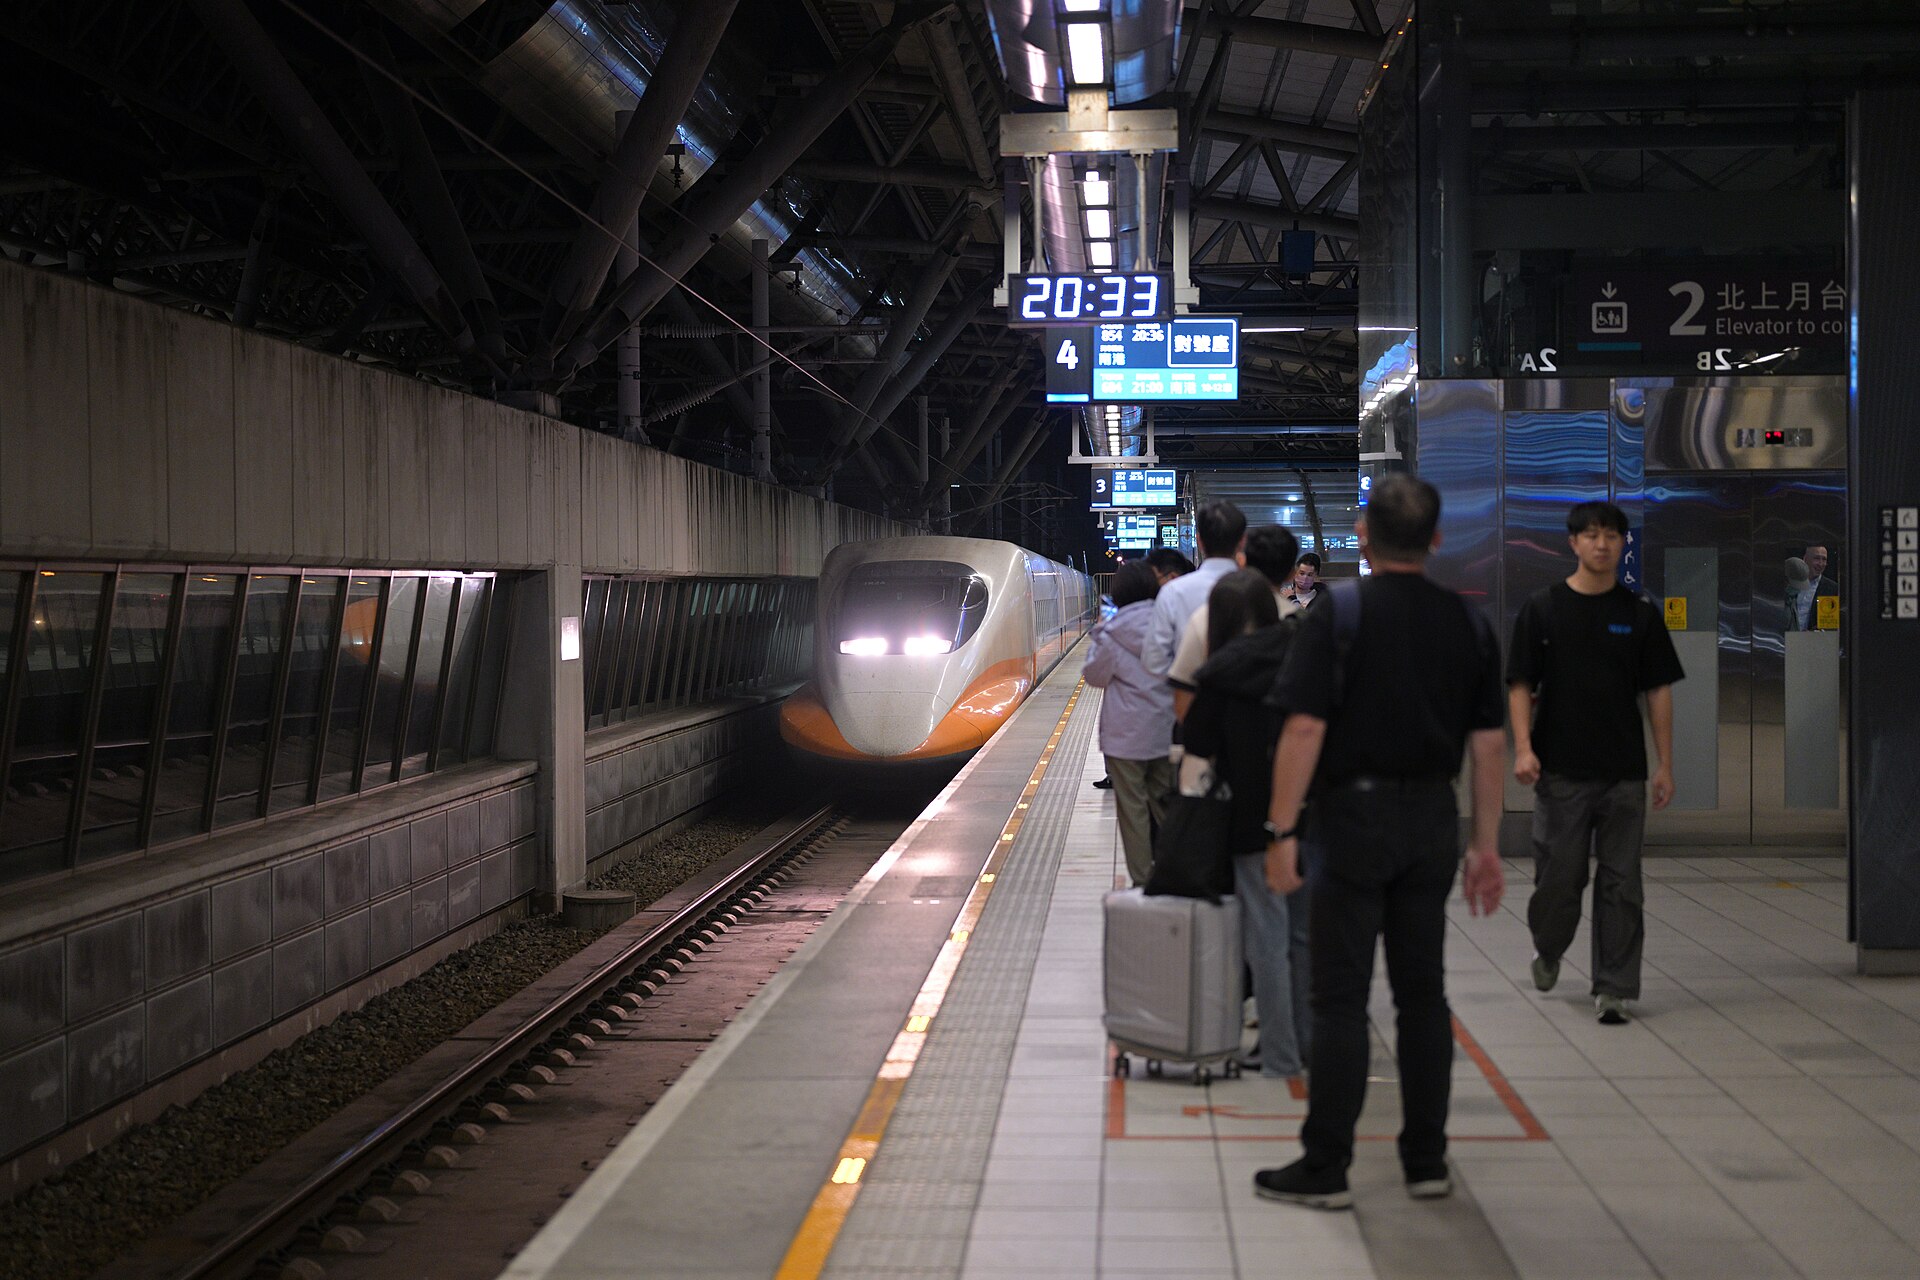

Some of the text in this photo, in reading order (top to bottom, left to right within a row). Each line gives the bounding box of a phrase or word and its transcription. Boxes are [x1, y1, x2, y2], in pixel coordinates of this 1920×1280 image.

[1022, 276, 1159, 318] 20:33
[1668, 281, 1706, 335] 2
[1716, 280, 1847, 311] 北上月台
[1716, 317, 1847, 335] Elevator to co
[1055, 339, 1079, 370] 4
[1095, 479, 1106, 493] 3
[1106, 520, 1114, 531] 2
